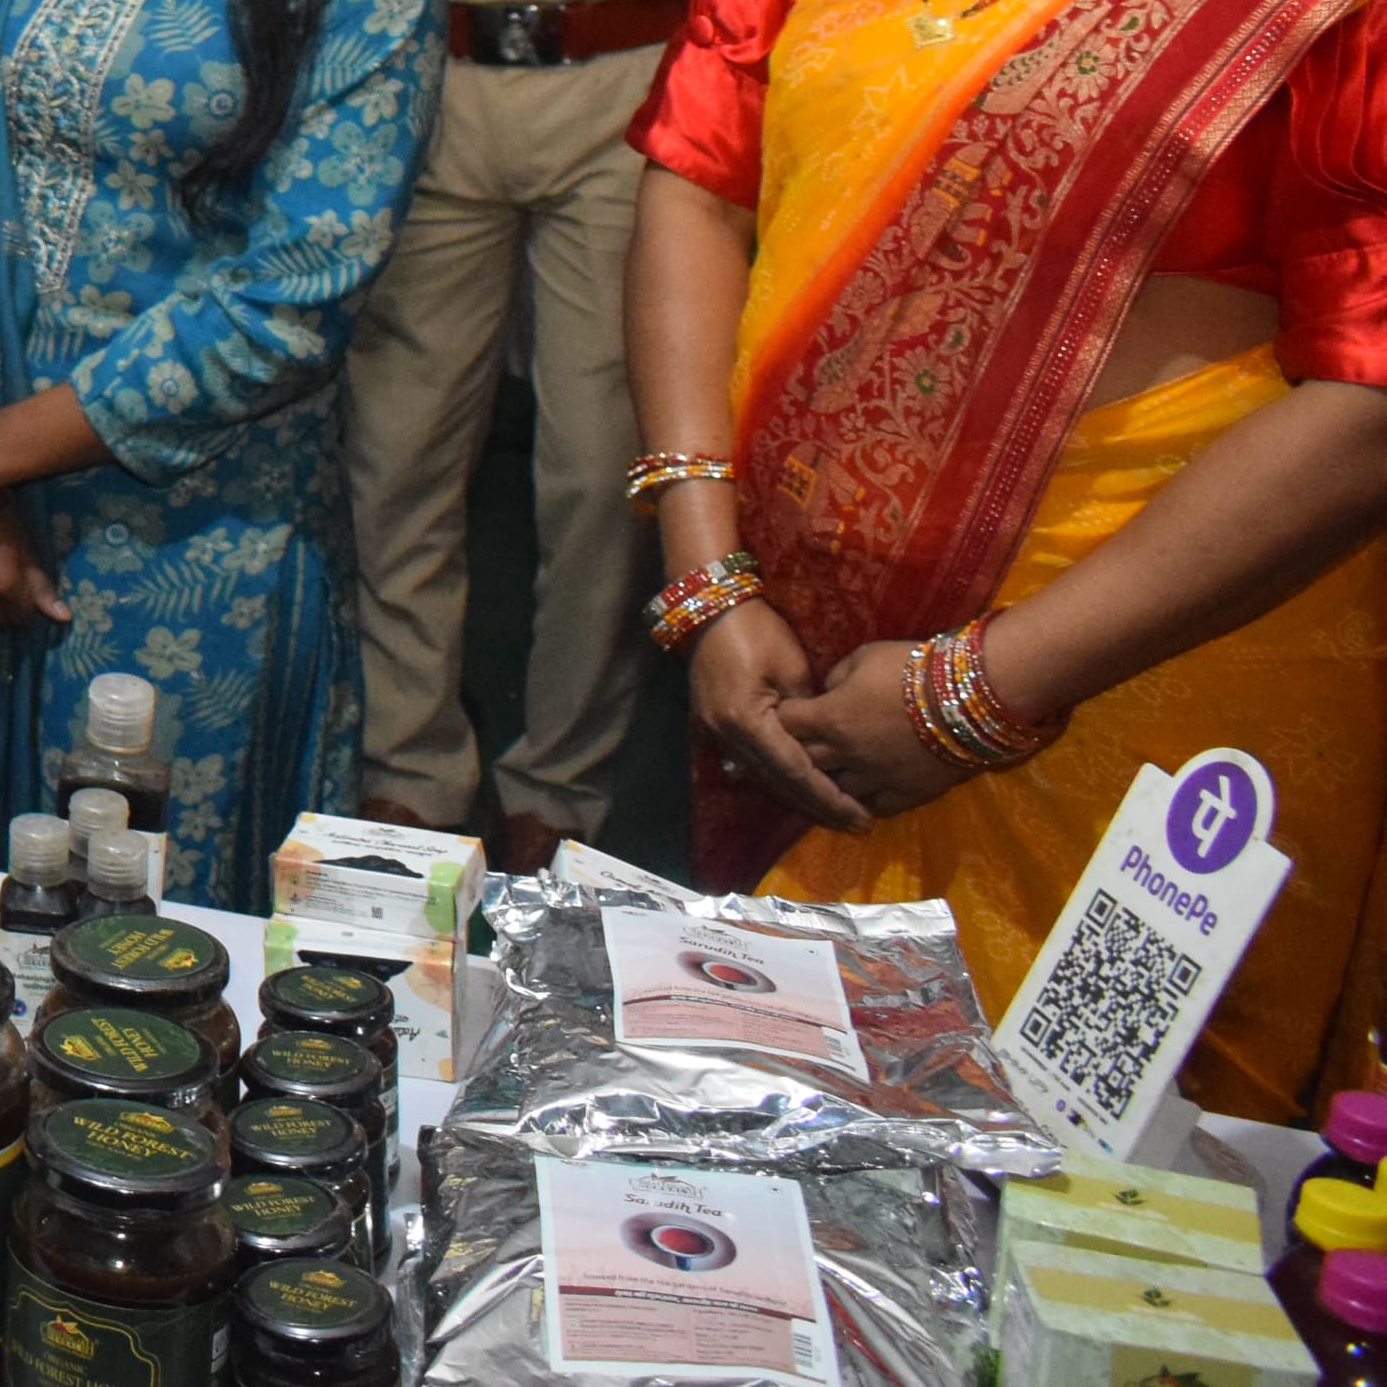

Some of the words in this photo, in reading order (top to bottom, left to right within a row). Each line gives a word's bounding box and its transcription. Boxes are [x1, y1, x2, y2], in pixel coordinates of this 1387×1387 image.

[1191, 775, 1238, 858] पे
[1121, 845, 1218, 936] PhonePe
[680, 935, 738, 960] Sarudih
[741, 952, 765, 965] Tea
[74, 1116, 119, 1135] WILD
[122, 1132, 190, 1159] FOREST
[87, 1130, 157, 1158] HONEY
[231, 1201, 265, 1213] WILD
[268, 1195, 316, 1207] FOREST
[254, 1204, 302, 1217] HONEY
[695, 1203, 722, 1217] Tea
[269, 1280, 304, 1295] WILD
[305, 1289, 357, 1308] FOREST
[281, 1293, 332, 1310] HONEY
